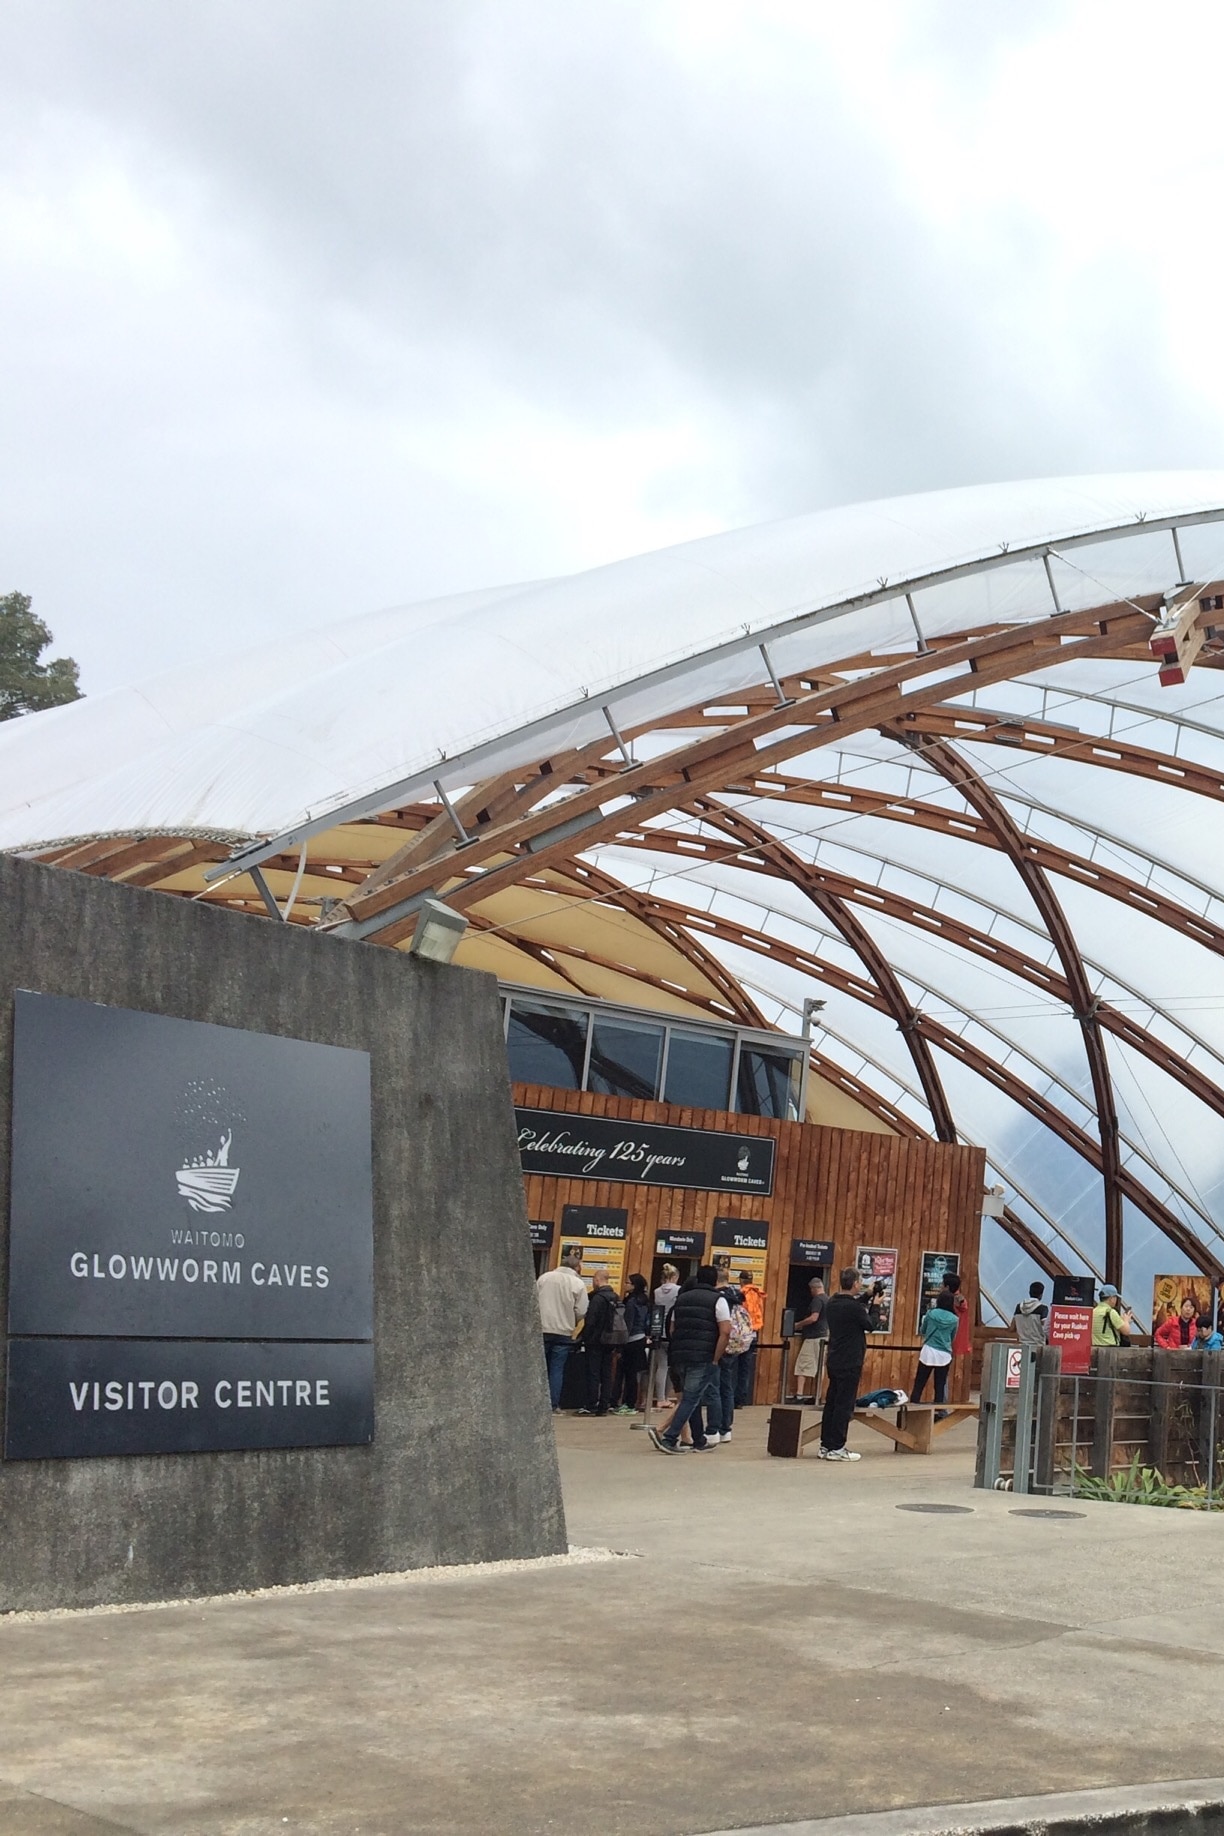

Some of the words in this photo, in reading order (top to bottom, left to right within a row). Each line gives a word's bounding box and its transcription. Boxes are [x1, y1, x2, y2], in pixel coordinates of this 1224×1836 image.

[518, 1127, 606, 1173] Celebrating
[608, 1140, 650, 1162] 125
[640, 1153, 687, 1178] years
[586, 1223, 625, 1237] Tickets
[170, 1229, 245, 1248] WAITOMO
[734, 1234, 766, 1248] Tickets
[70, 1251, 241, 1284] GLOWWORM
[251, 1262, 330, 1288] CAVES
[1054, 1311, 1069, 1320] Please
[1080, 1313, 1089, 1321] here
[1053, 1331, 1064, 1339] Cave
[69, 1381, 199, 1411] VISITOR
[214, 1380, 330, 1408] CENTRE
